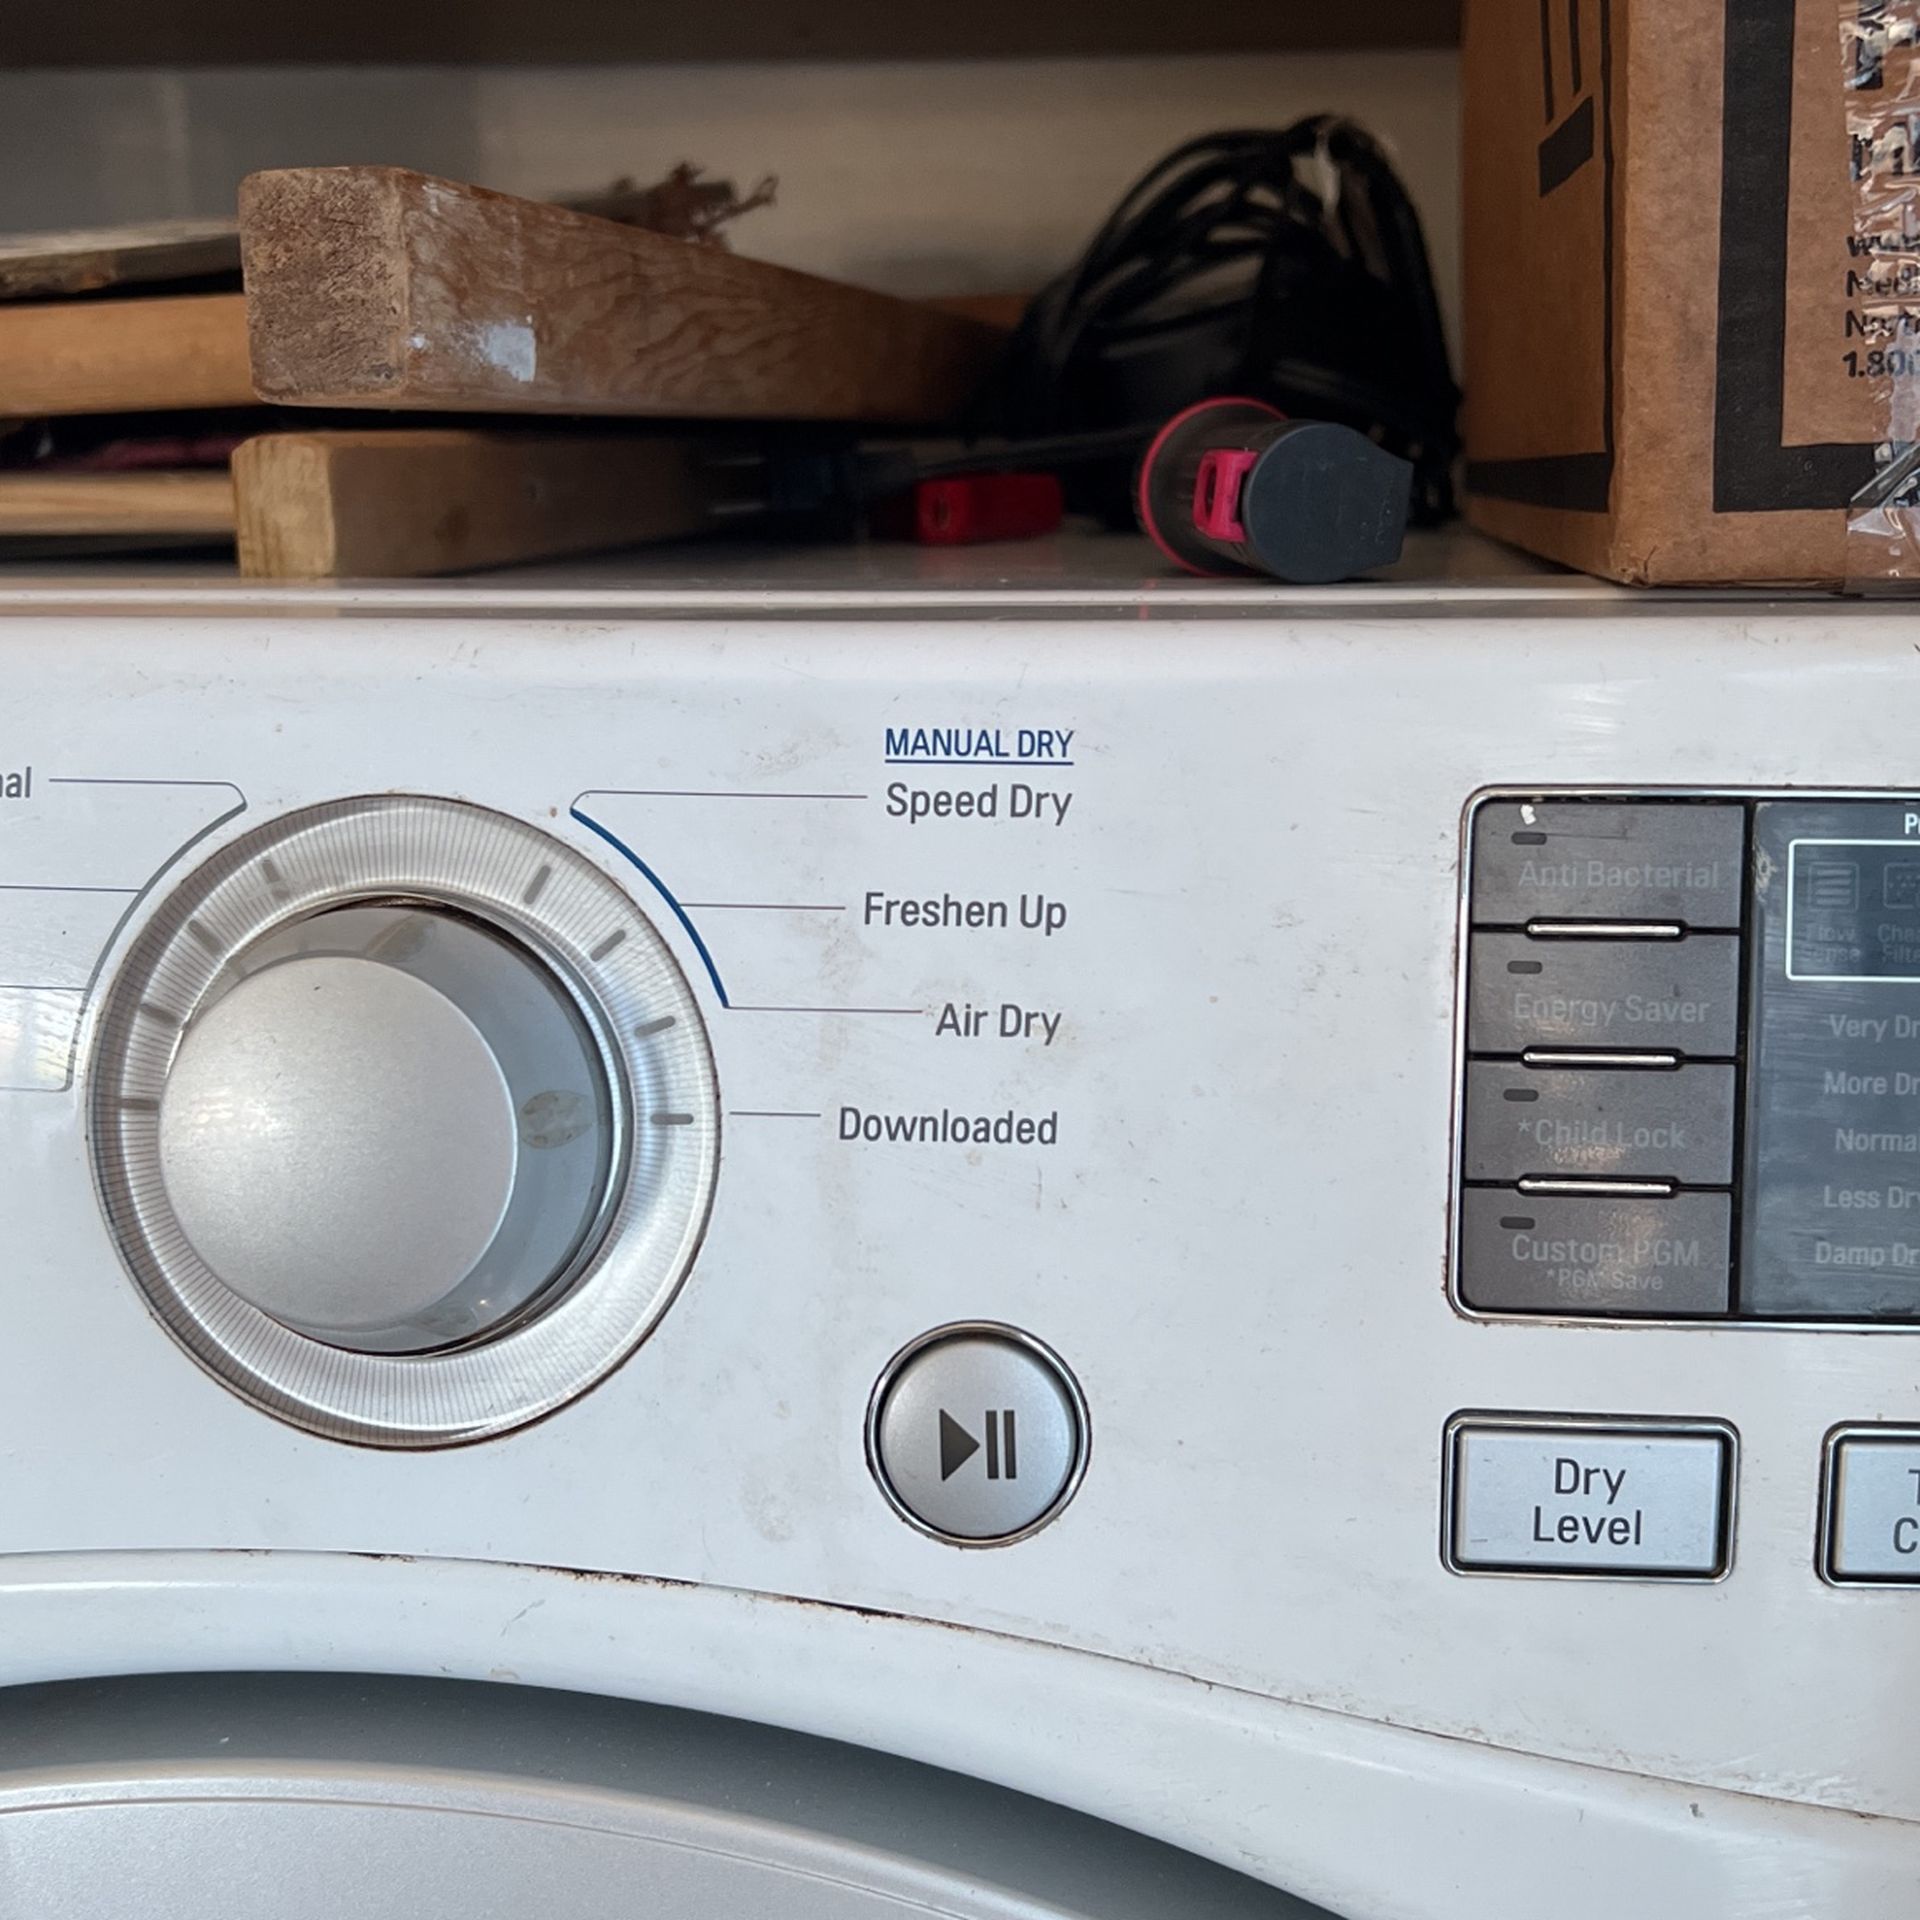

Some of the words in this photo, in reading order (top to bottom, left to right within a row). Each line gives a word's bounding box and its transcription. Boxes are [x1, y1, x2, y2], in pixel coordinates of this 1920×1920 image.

[885, 728, 1009, 757] MANUAL
[1017, 729, 1074, 758] DRY
[0, 766, 32, 798] al
[885, 781, 998, 824] Speed
[1009, 784, 1073, 826] Dry
[1518, 860, 1577, 888] Anti
[1586, 860, 1720, 889] Bacterial
[864, 891, 1008, 928] Freshen
[1019, 894, 1067, 936] Up
[935, 1003, 988, 1037] Air
[999, 1004, 1062, 1046] Dry
[1514, 993, 1617, 1027] Energy
[1624, 994, 1711, 1024] Saver
[1828, 1013, 1888, 1043] Very
[1823, 1070, 1888, 1095] More
[839, 1106, 1058, 1145] Downloaded
[1617, 1120, 1686, 1149] Lock
[1834, 1127, 1920, 1153] Norma
[1823, 1184, 1881, 1209] Less
[1511, 1233, 1622, 1264] Custom
[1633, 1239, 1700, 1267] PGM
[1814, 1240, 1886, 1267] Damp
[1611, 1270, 1664, 1291] Save
[1554, 1457, 1627, 1505] Dry
[1532, 1505, 1642, 1546] Level
